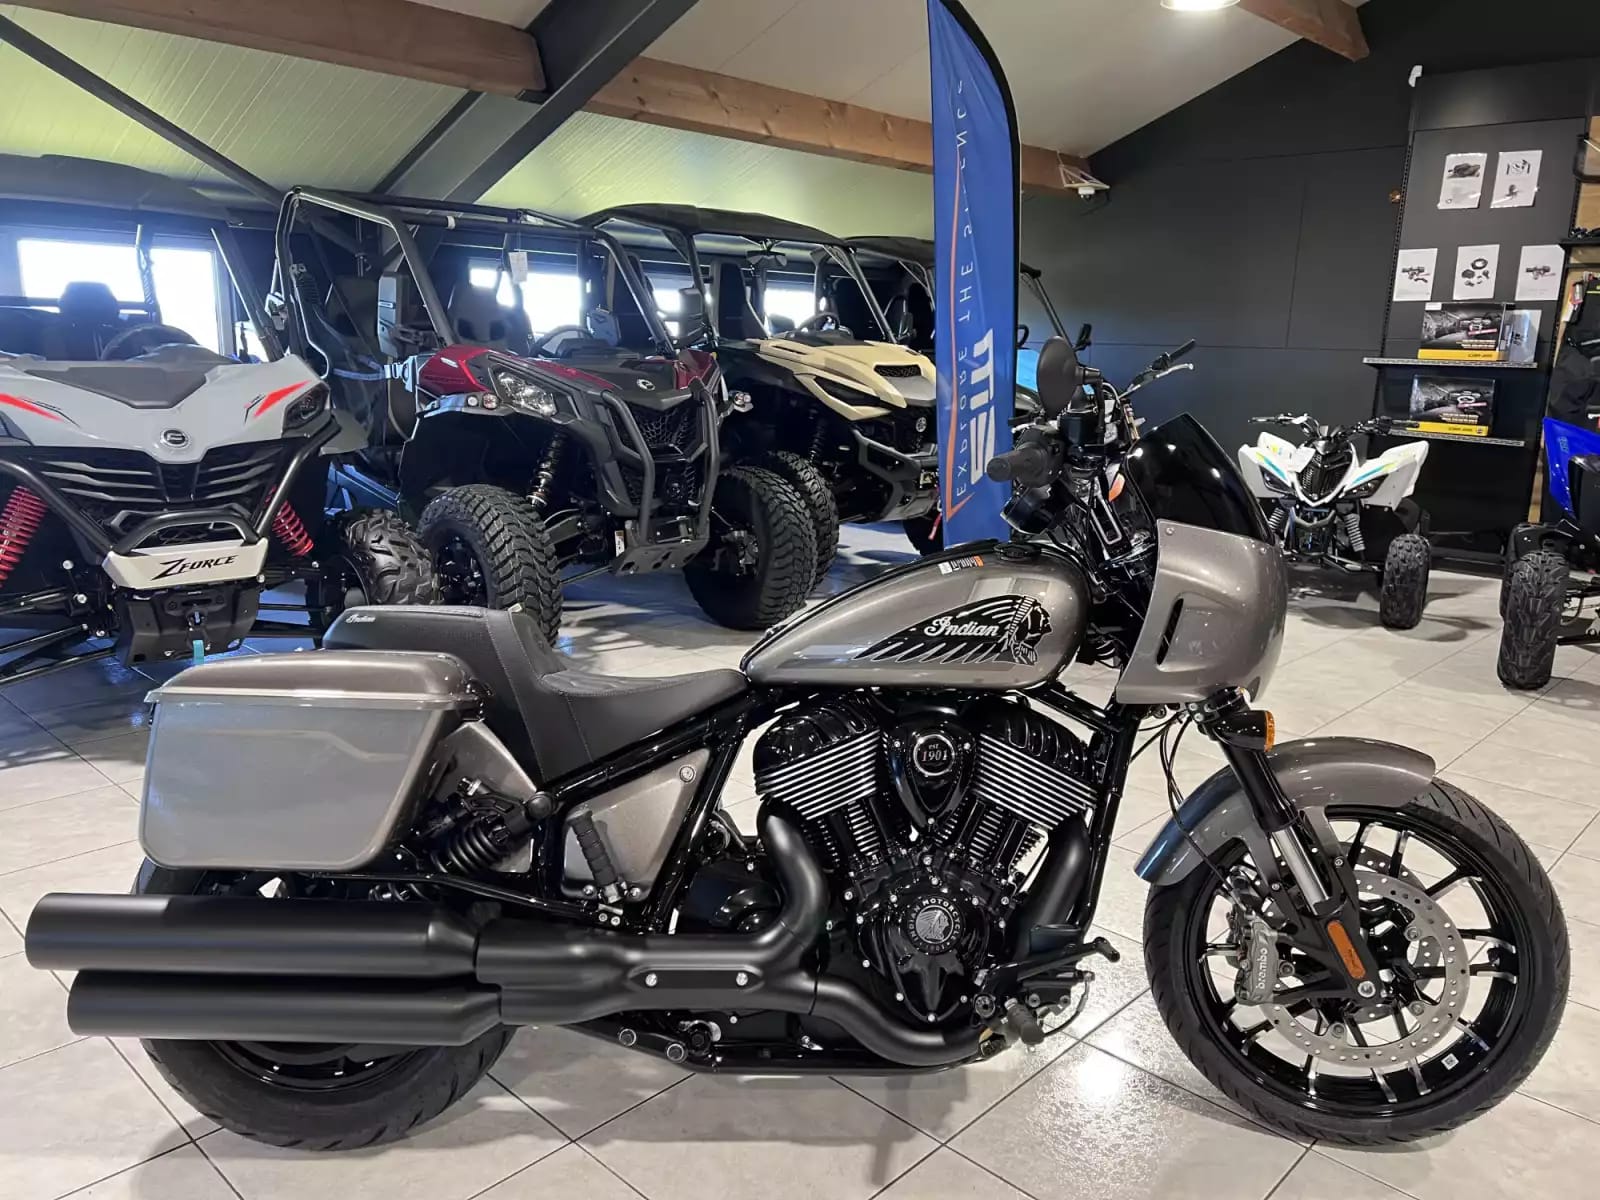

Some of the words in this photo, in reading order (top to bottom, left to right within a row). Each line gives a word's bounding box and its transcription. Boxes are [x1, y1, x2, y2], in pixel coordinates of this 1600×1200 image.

[923, 615, 1000, 637] Indian
[921, 749, 948, 762] 1901
[908, 904, 921, 942] INDIAN
[922, 897, 961, 940] MOTORCYCLE
[1255, 947, 1268, 990] brembo
